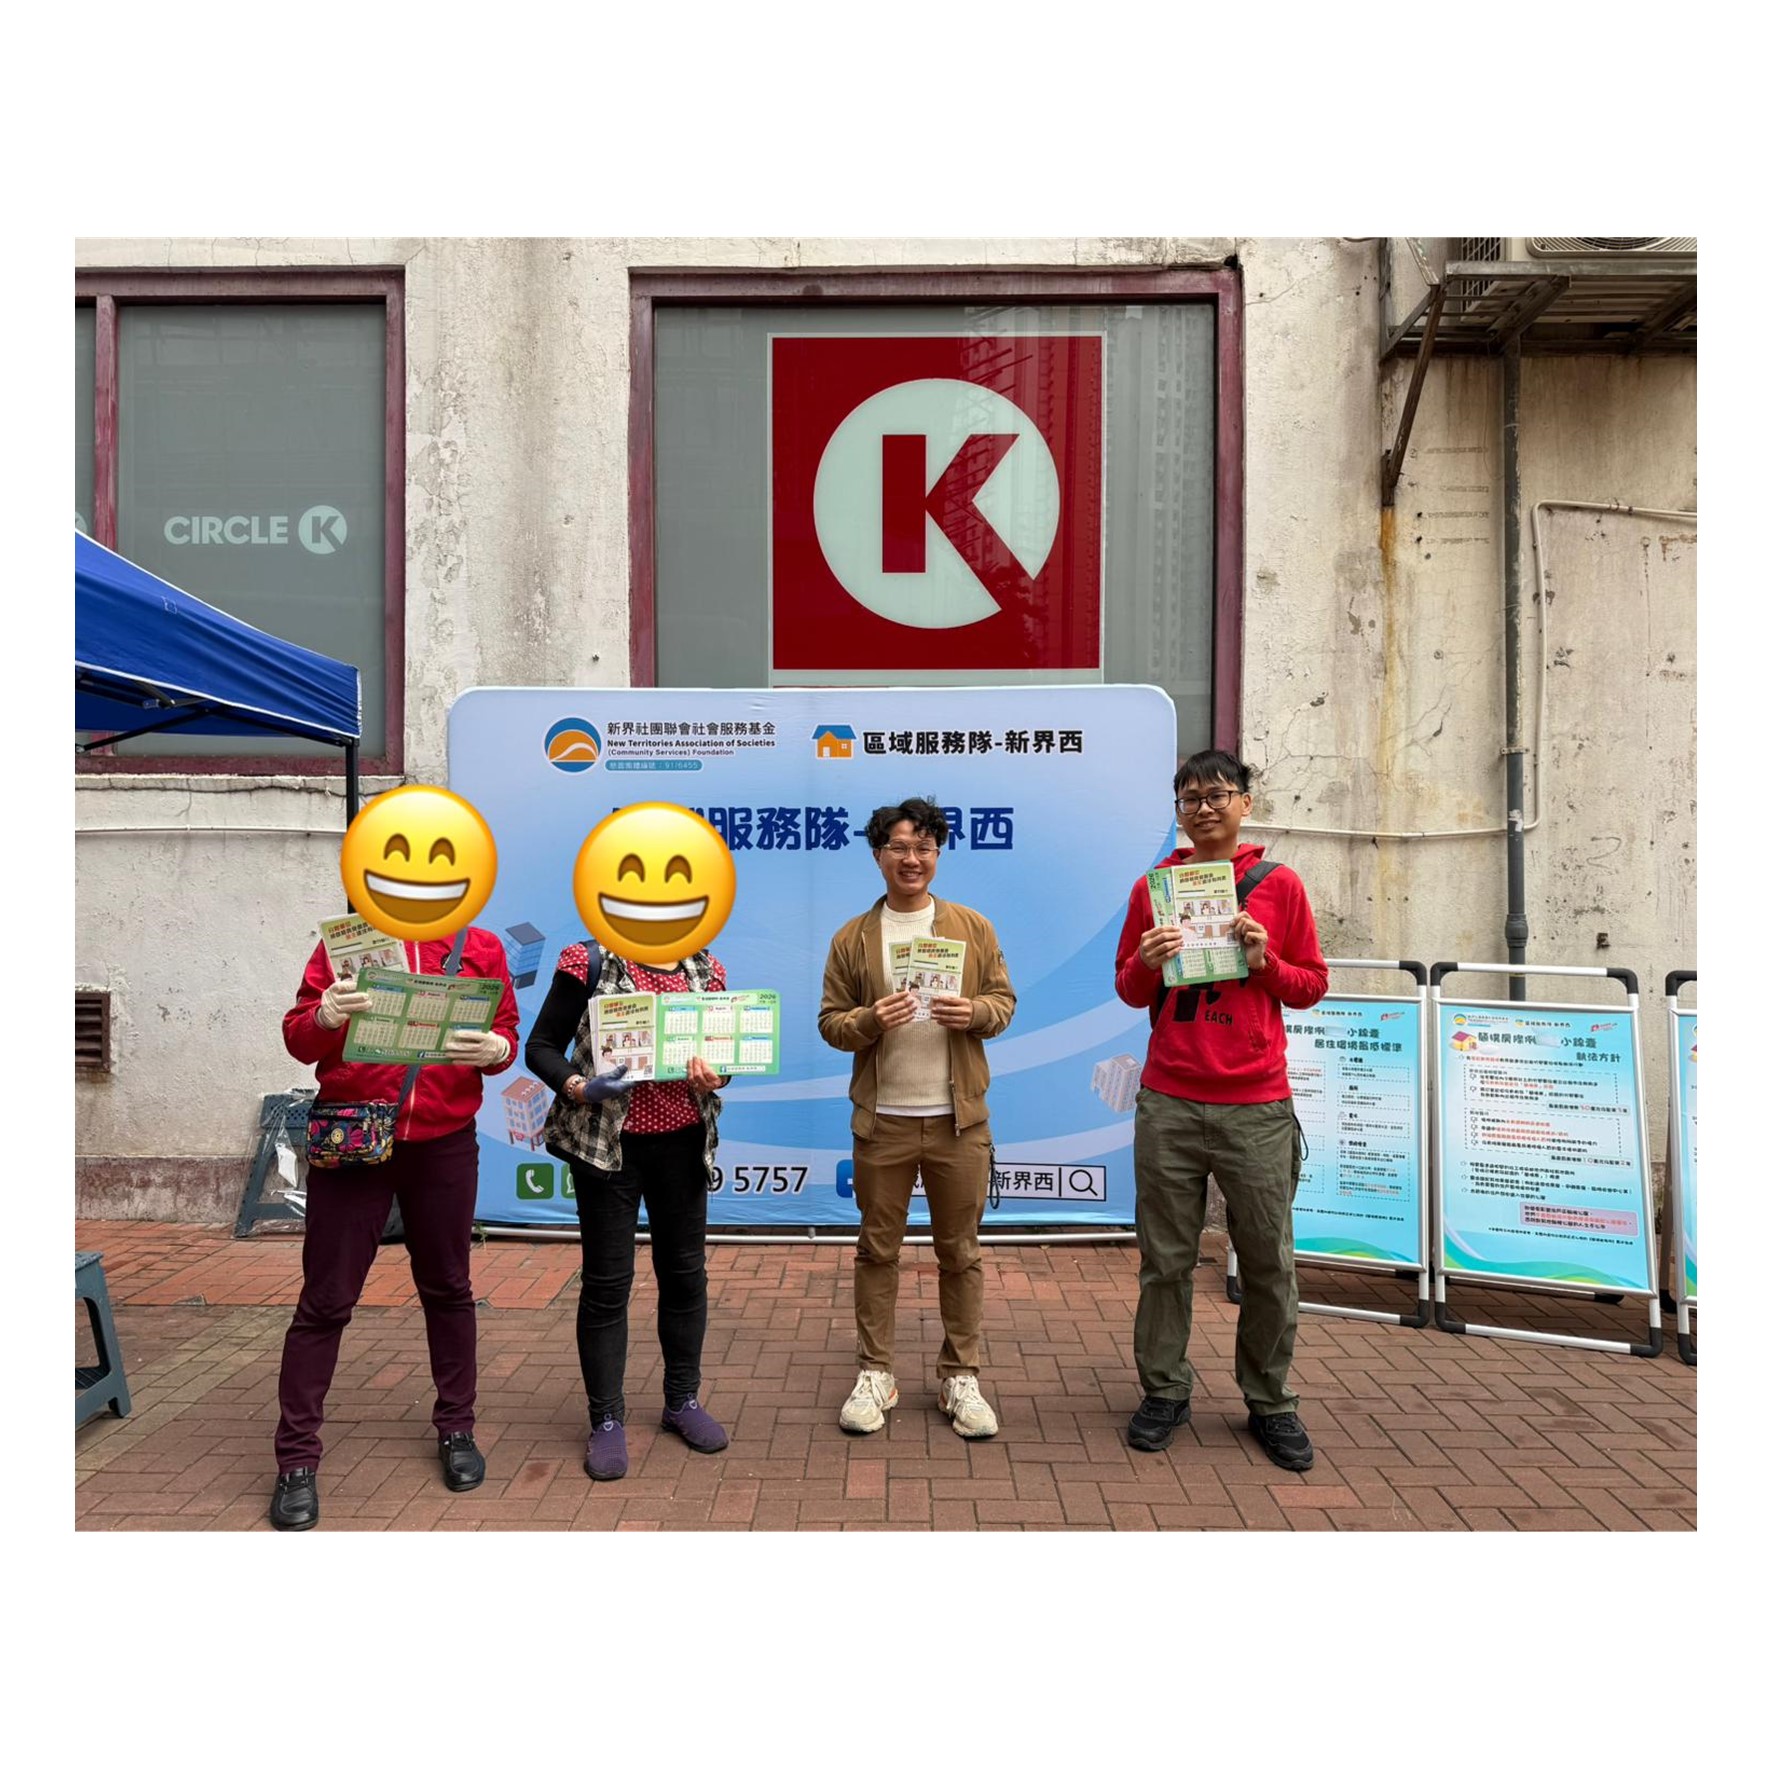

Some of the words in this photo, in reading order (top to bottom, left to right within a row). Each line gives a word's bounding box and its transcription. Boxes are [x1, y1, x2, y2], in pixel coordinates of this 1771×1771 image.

[164, 515, 288, 544] CIRCLE
[308, 512, 344, 552] K
[606, 721, 776, 736] 新界社團聯會社會服務基金
[607, 739, 627, 748] New
[629, 739, 673, 748] Territories
[675, 739, 724, 748] Association
[725, 739, 735, 748] of
[736, 739, 776, 748] Societies
[862, 730, 1083, 755] 區域服務隊-新界西
[607, 749, 653, 757] (Community
[655, 749, 691, 757] Services)
[692, 749, 735, 757] Foundation
[733, 1166, 809, 1193] 5757
